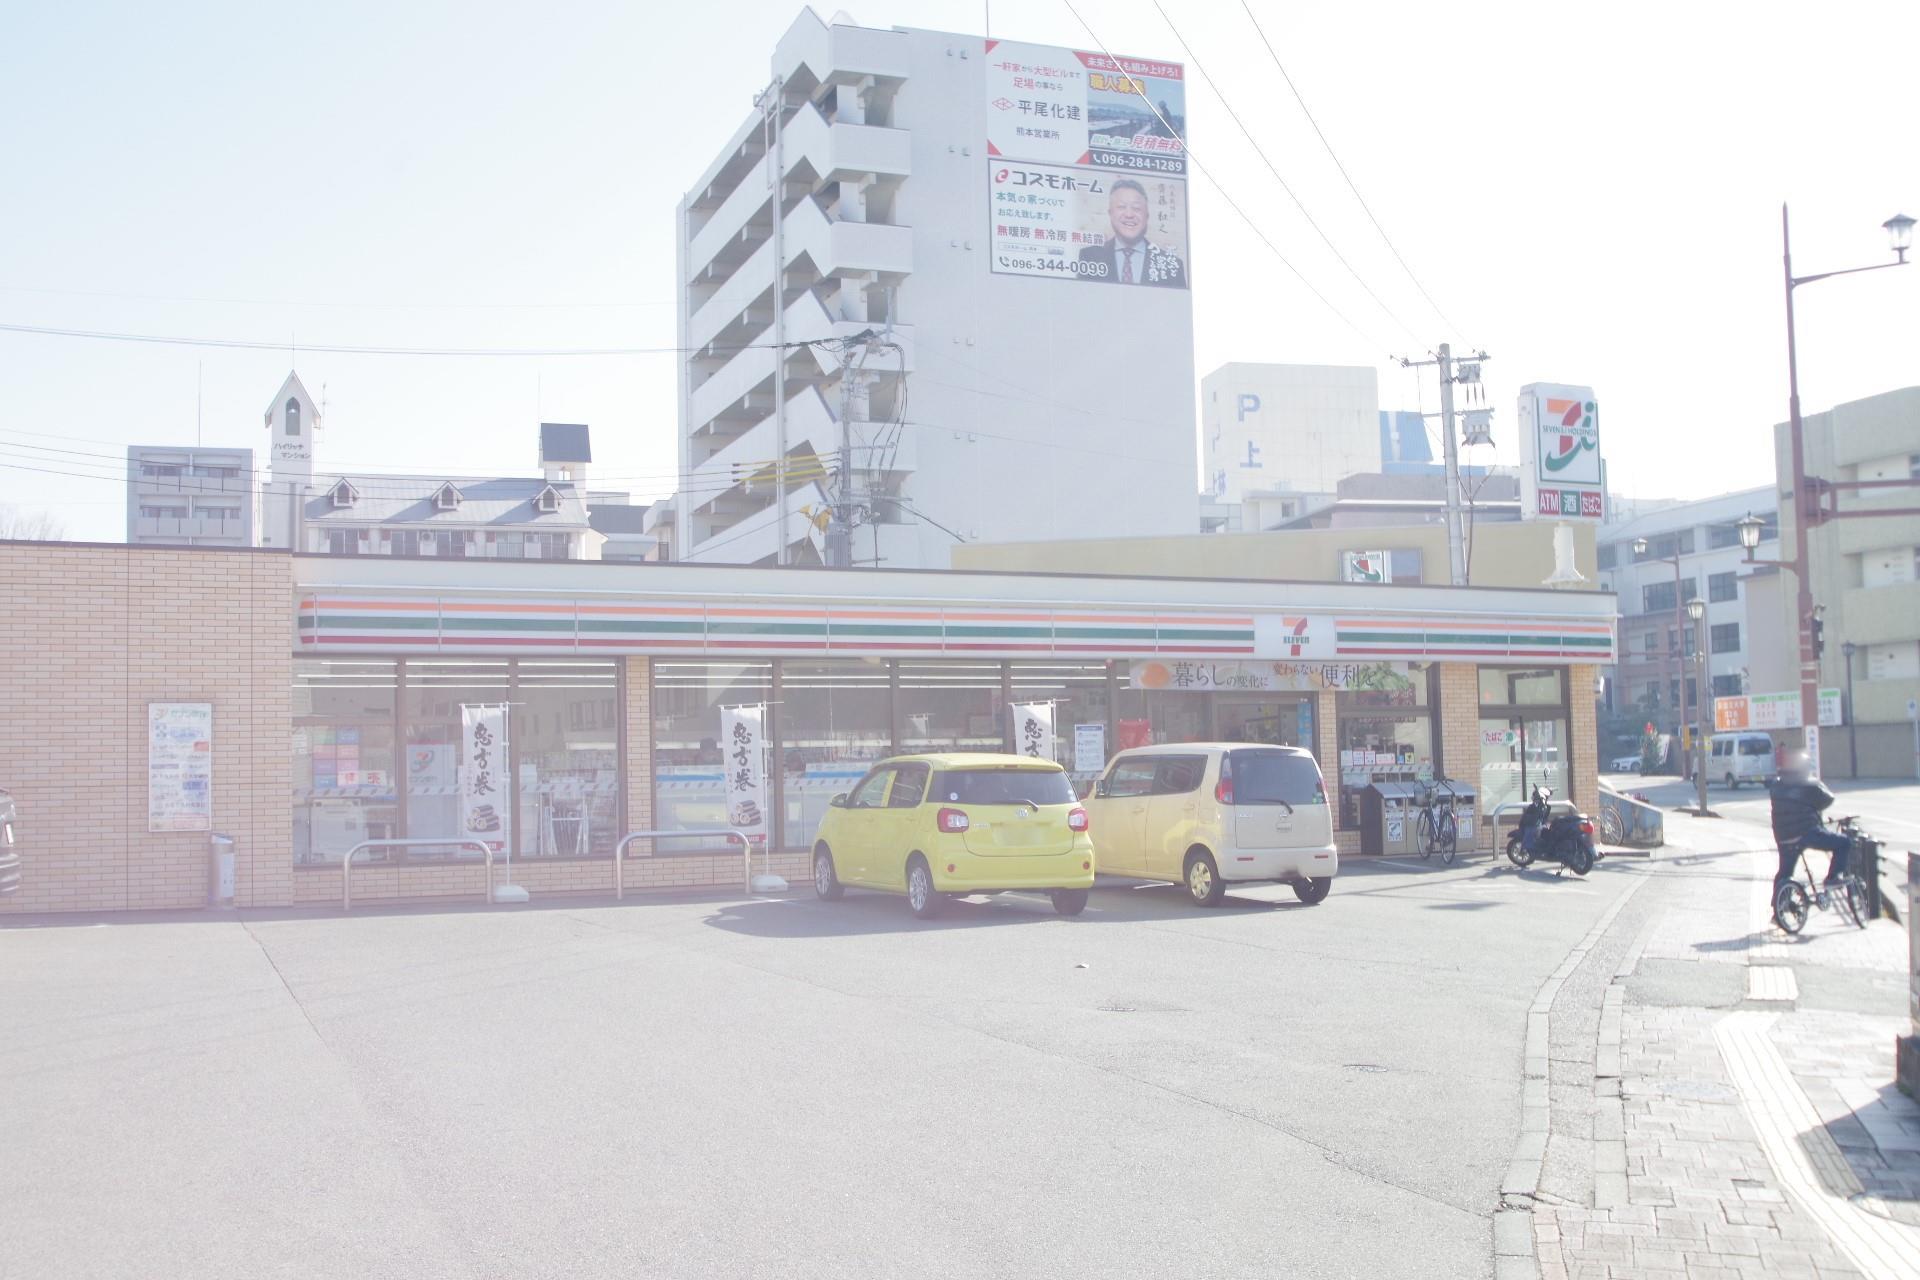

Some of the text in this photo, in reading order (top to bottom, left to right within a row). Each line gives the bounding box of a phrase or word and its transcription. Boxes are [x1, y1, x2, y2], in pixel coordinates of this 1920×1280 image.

[1014, 77, 1064, 91] 足場の事なら
[1017, 99, 1081, 121] 平尾化建
[1016, 127, 1061, 141] 熊本営業所
[1102, 153, 1183, 172] 096-284-1289
[1012, 170, 1104, 193] コスモホーム
[996, 192, 1065, 207] 本気の家づくりで
[997, 224, 1030, 239] 無暖房
[1034, 228, 1067, 242] 無冷房
[1011, 257, 1108, 276] 096-344-0099
[1237, 393, 1261, 422] P
[1540, 493, 1602, 513] ATM 酒 たばこ
[1485, 731, 1503, 743] たばこ
[474, 721, 496, 796] 恵方巻
[733, 721, 757, 792] 恵方巻
